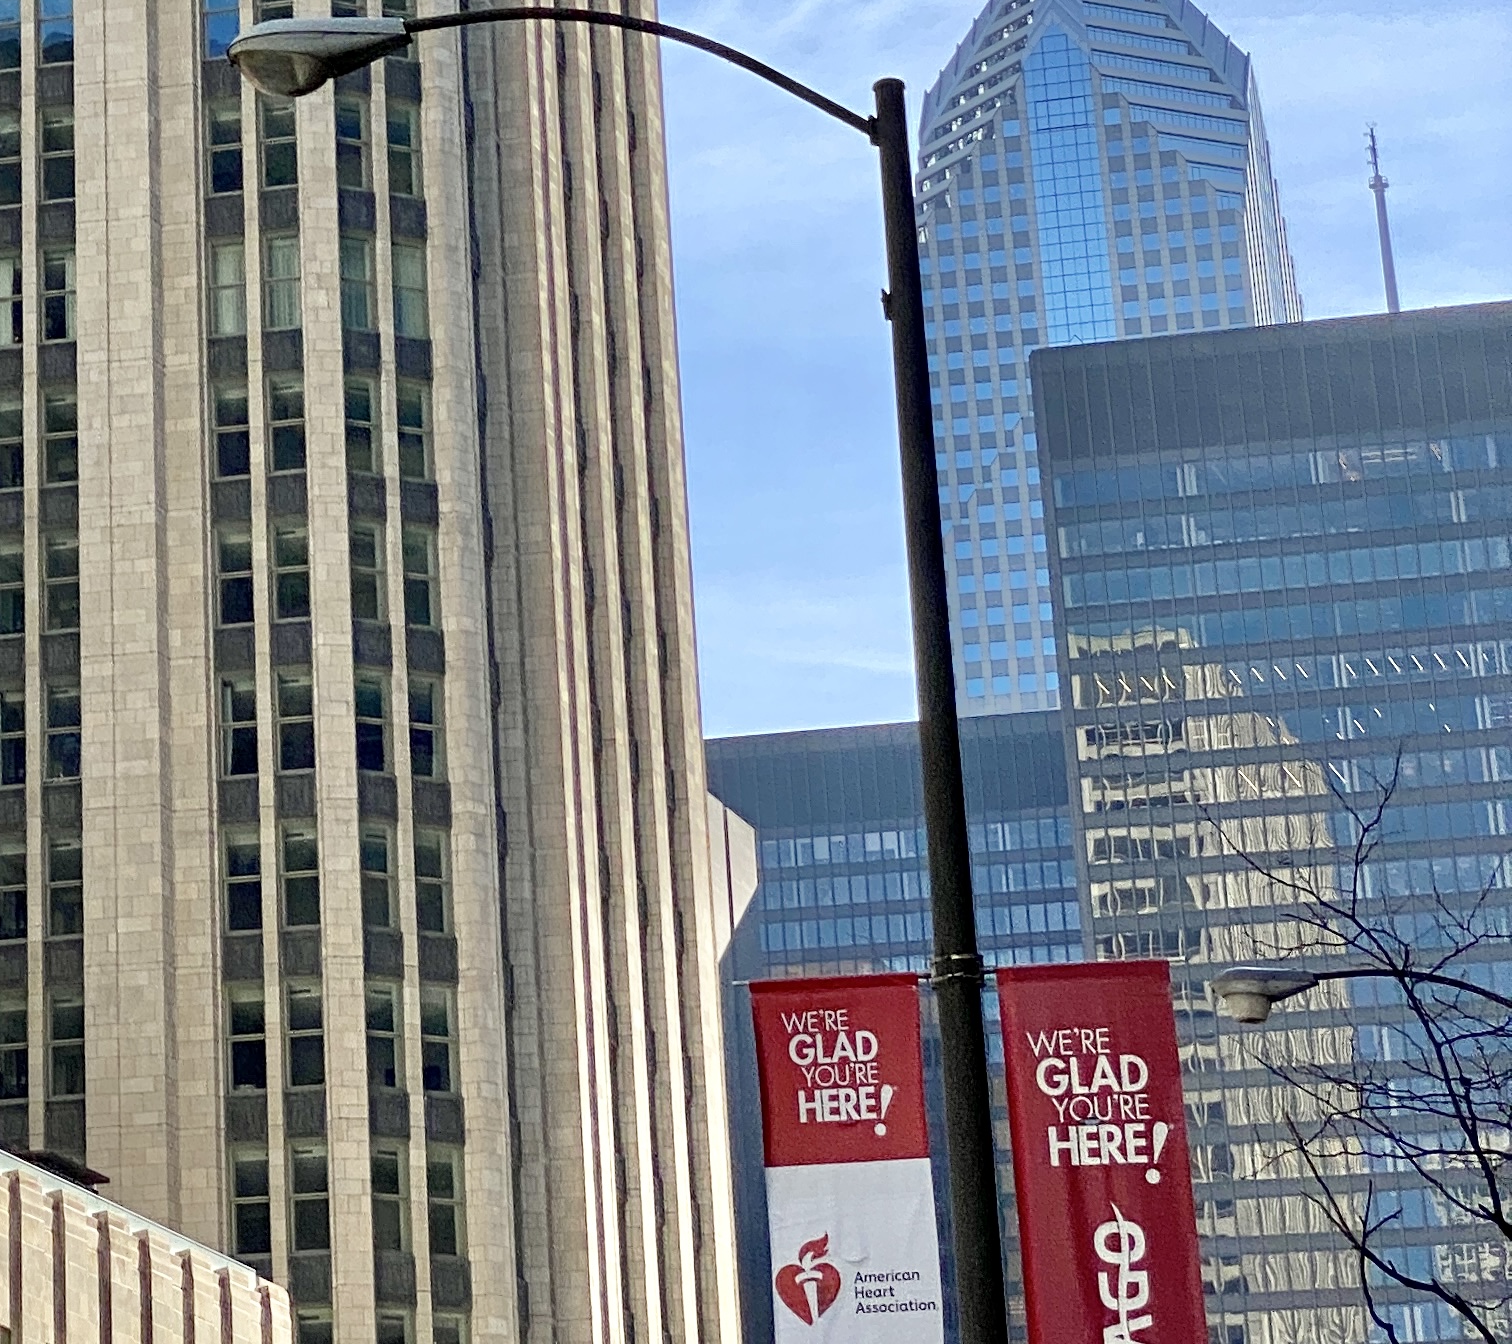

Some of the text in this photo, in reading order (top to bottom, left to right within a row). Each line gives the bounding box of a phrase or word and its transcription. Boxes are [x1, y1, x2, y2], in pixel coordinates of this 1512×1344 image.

[780, 1009, 849, 1033] WE'RE
[788, 1030, 879, 1066] GLAD
[1026, 1027, 1111, 1057] WE'RE
[800, 1062, 879, 1088] YOU'RE
[1036, 1054, 1149, 1096] GLAD
[798, 1084, 894, 1136] HERE!
[1052, 1093, 1153, 1123] YOU'RE
[1047, 1121, 1169, 1184] HERE!
[854, 1270, 920, 1284] American
[854, 1285, 895, 1299] Heart
[855, 1299, 936, 1315] Association
